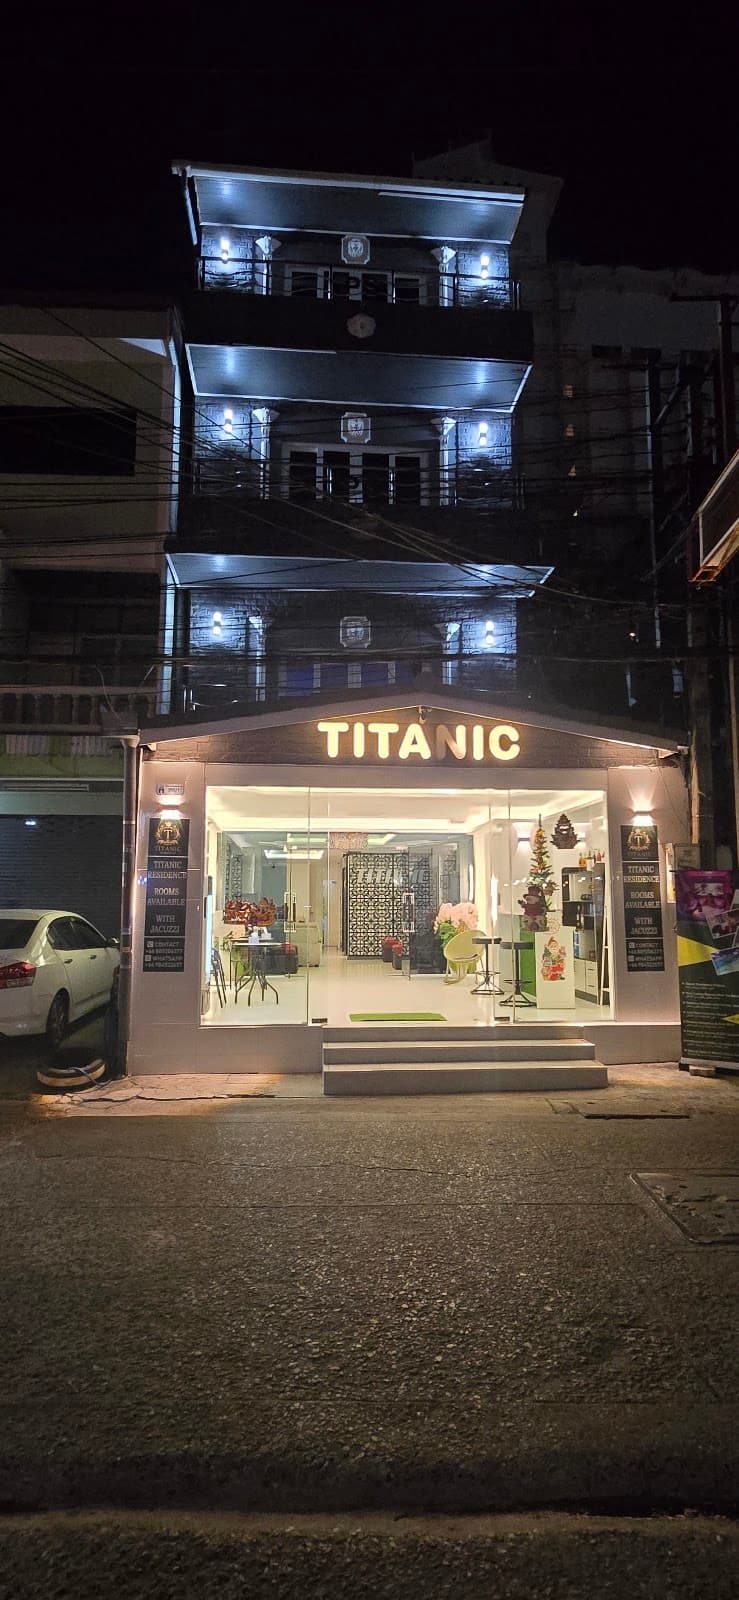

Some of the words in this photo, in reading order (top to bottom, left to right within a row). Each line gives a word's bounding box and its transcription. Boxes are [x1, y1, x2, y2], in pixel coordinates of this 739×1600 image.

[318, 722, 520, 760] TITANIC
[153, 861, 183, 869] TITANIC
[628, 865, 655, 873] TITANIC
[623, 875, 660, 883] RESIDENCE
[154, 887, 180, 896] ROOMS
[630, 891, 654, 899] ROOMS
[147, 898, 185, 906] AVAILABLE
[625, 901, 661, 909] AVAILABLE
[156, 914, 176, 923] WITH
[634, 917, 653, 925] WITH
[150, 925, 180, 933] JACUZZI
